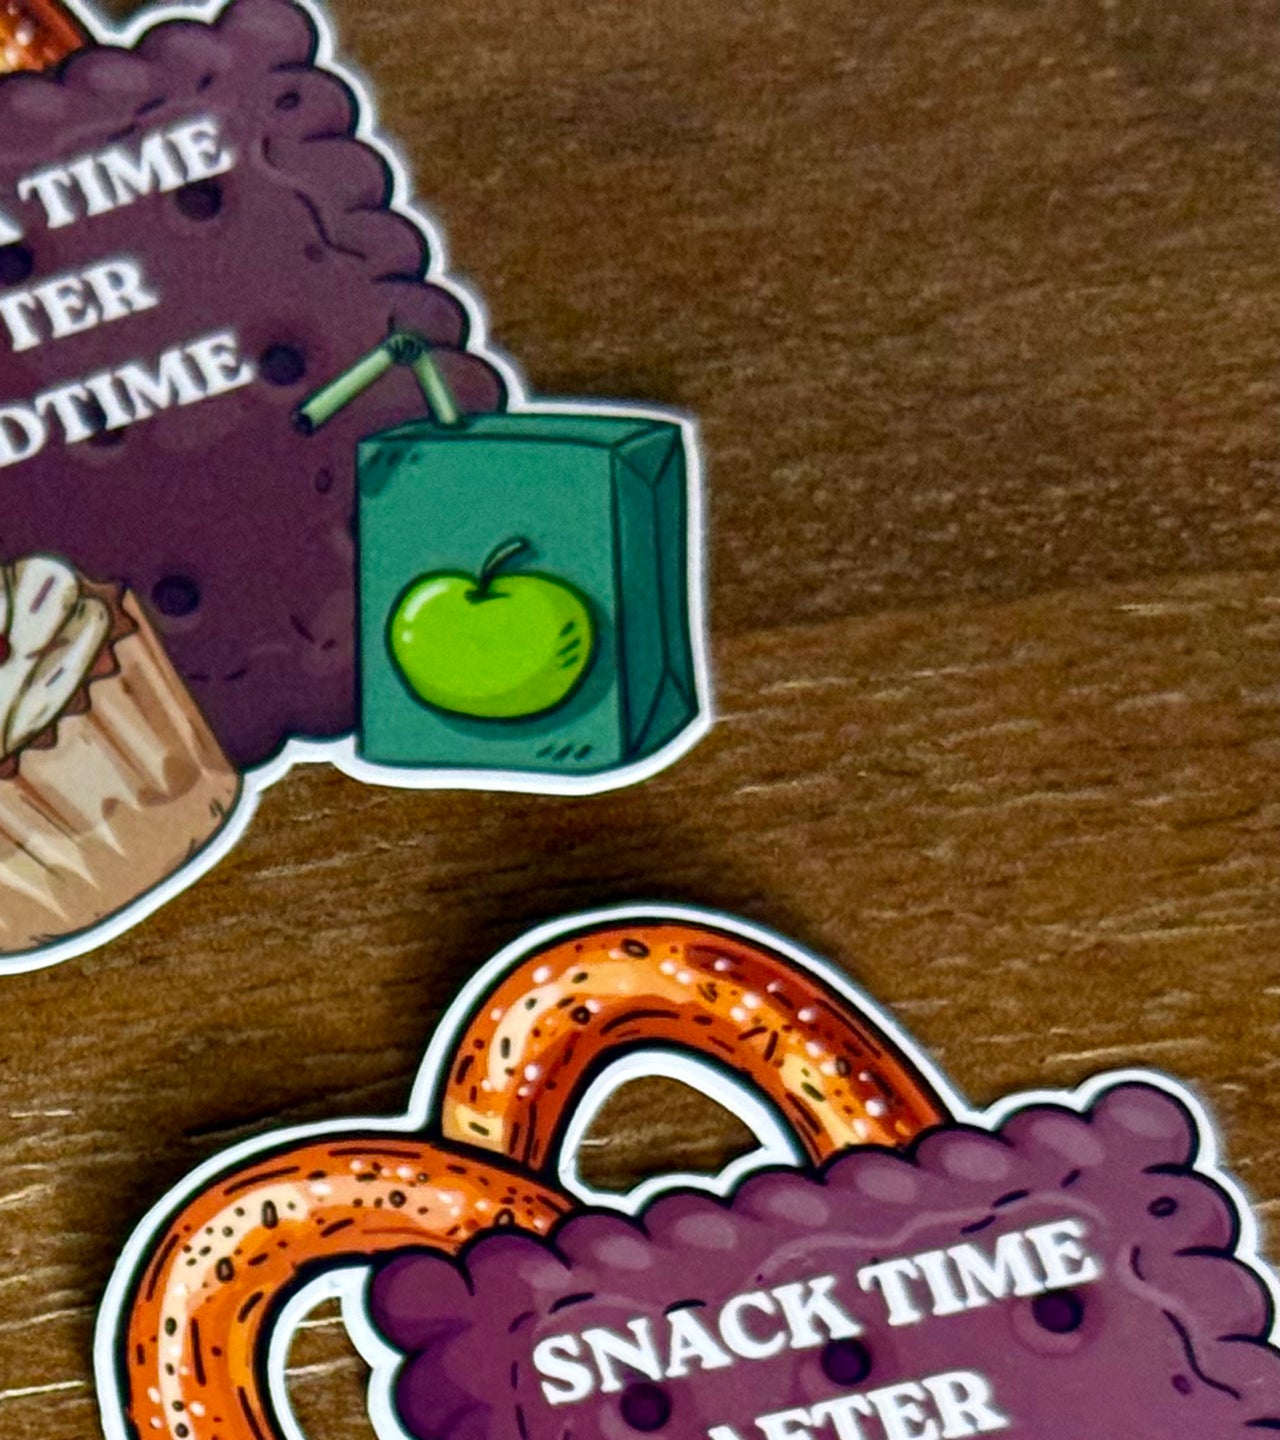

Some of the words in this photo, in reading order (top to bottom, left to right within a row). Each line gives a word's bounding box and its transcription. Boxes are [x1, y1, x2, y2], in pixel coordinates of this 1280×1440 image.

[16, 114, 237, 230] TIME
[531, 1273, 864, 1407] SNACK
[855, 1217, 1105, 1328] TIME
